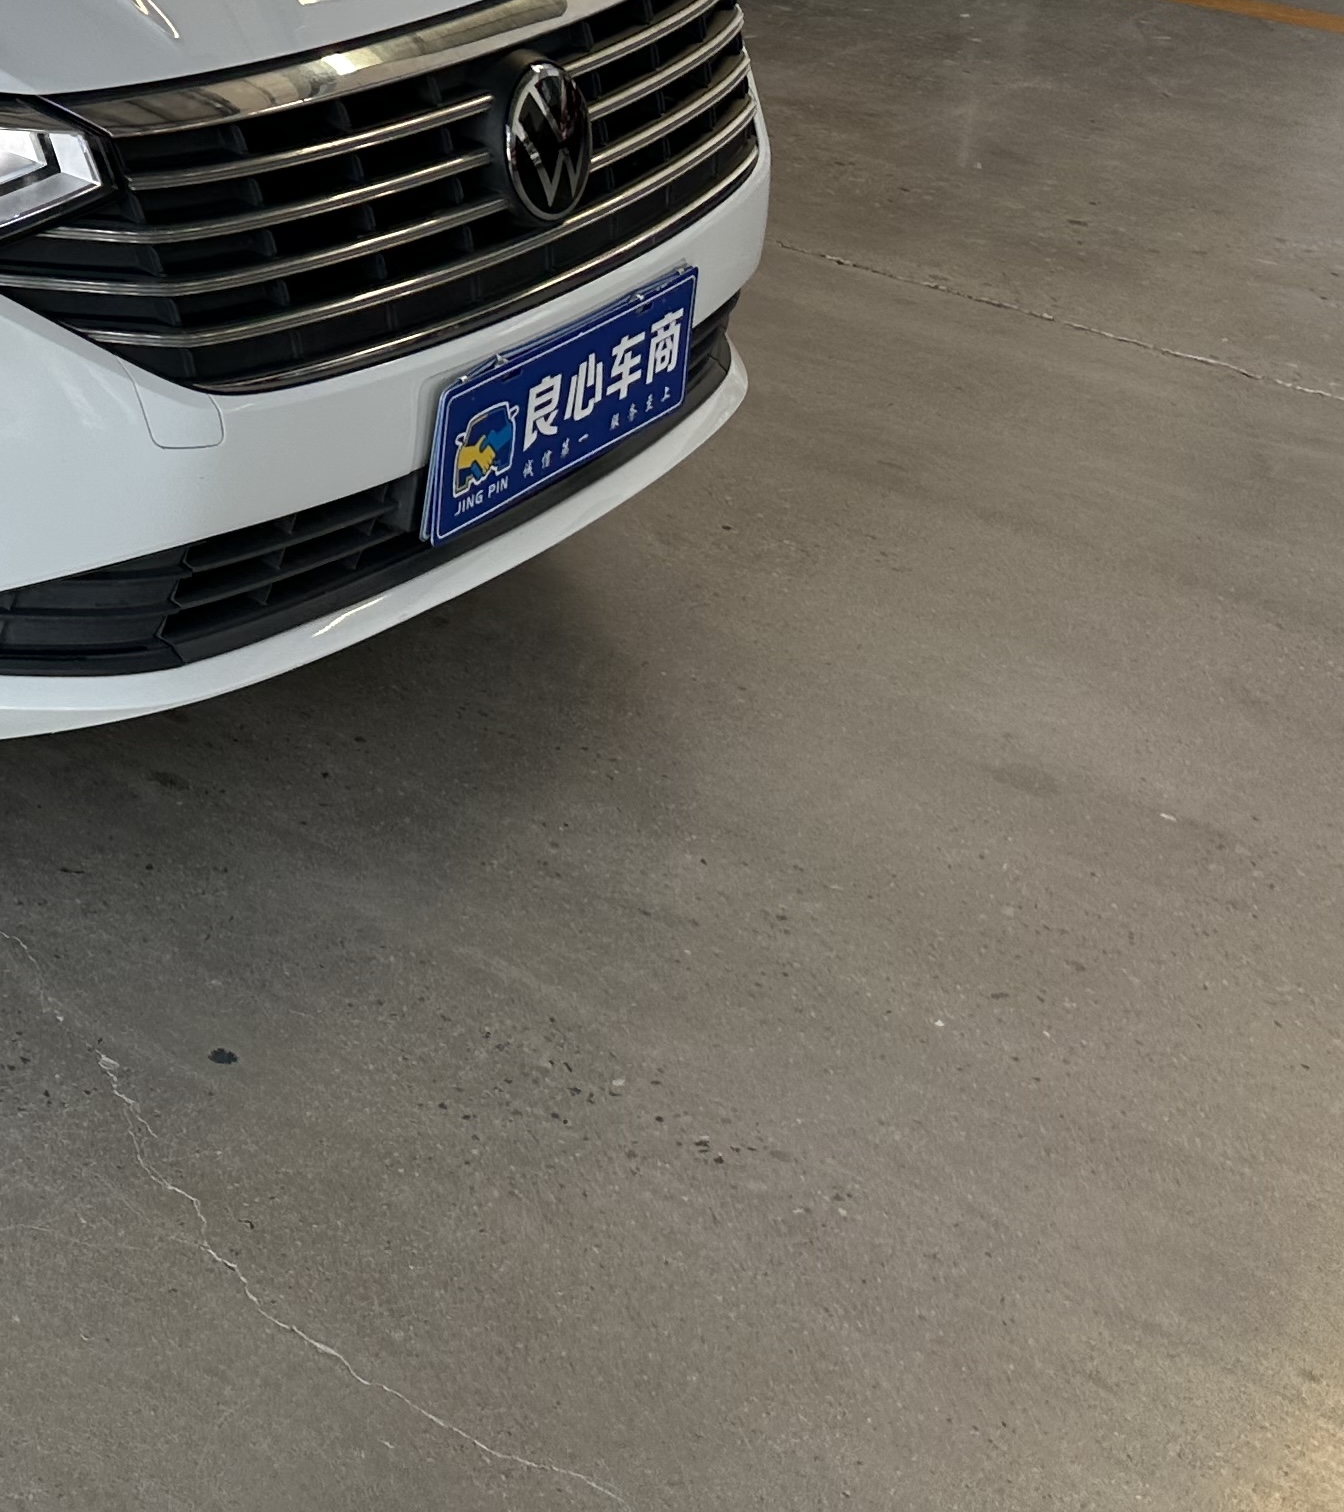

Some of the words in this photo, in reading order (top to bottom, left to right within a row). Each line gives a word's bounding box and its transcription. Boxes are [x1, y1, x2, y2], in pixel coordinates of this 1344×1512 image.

[523, 307, 684, 452] 良心车商
[454, 492, 484, 516] JING
[487, 478, 509, 499] PIN
